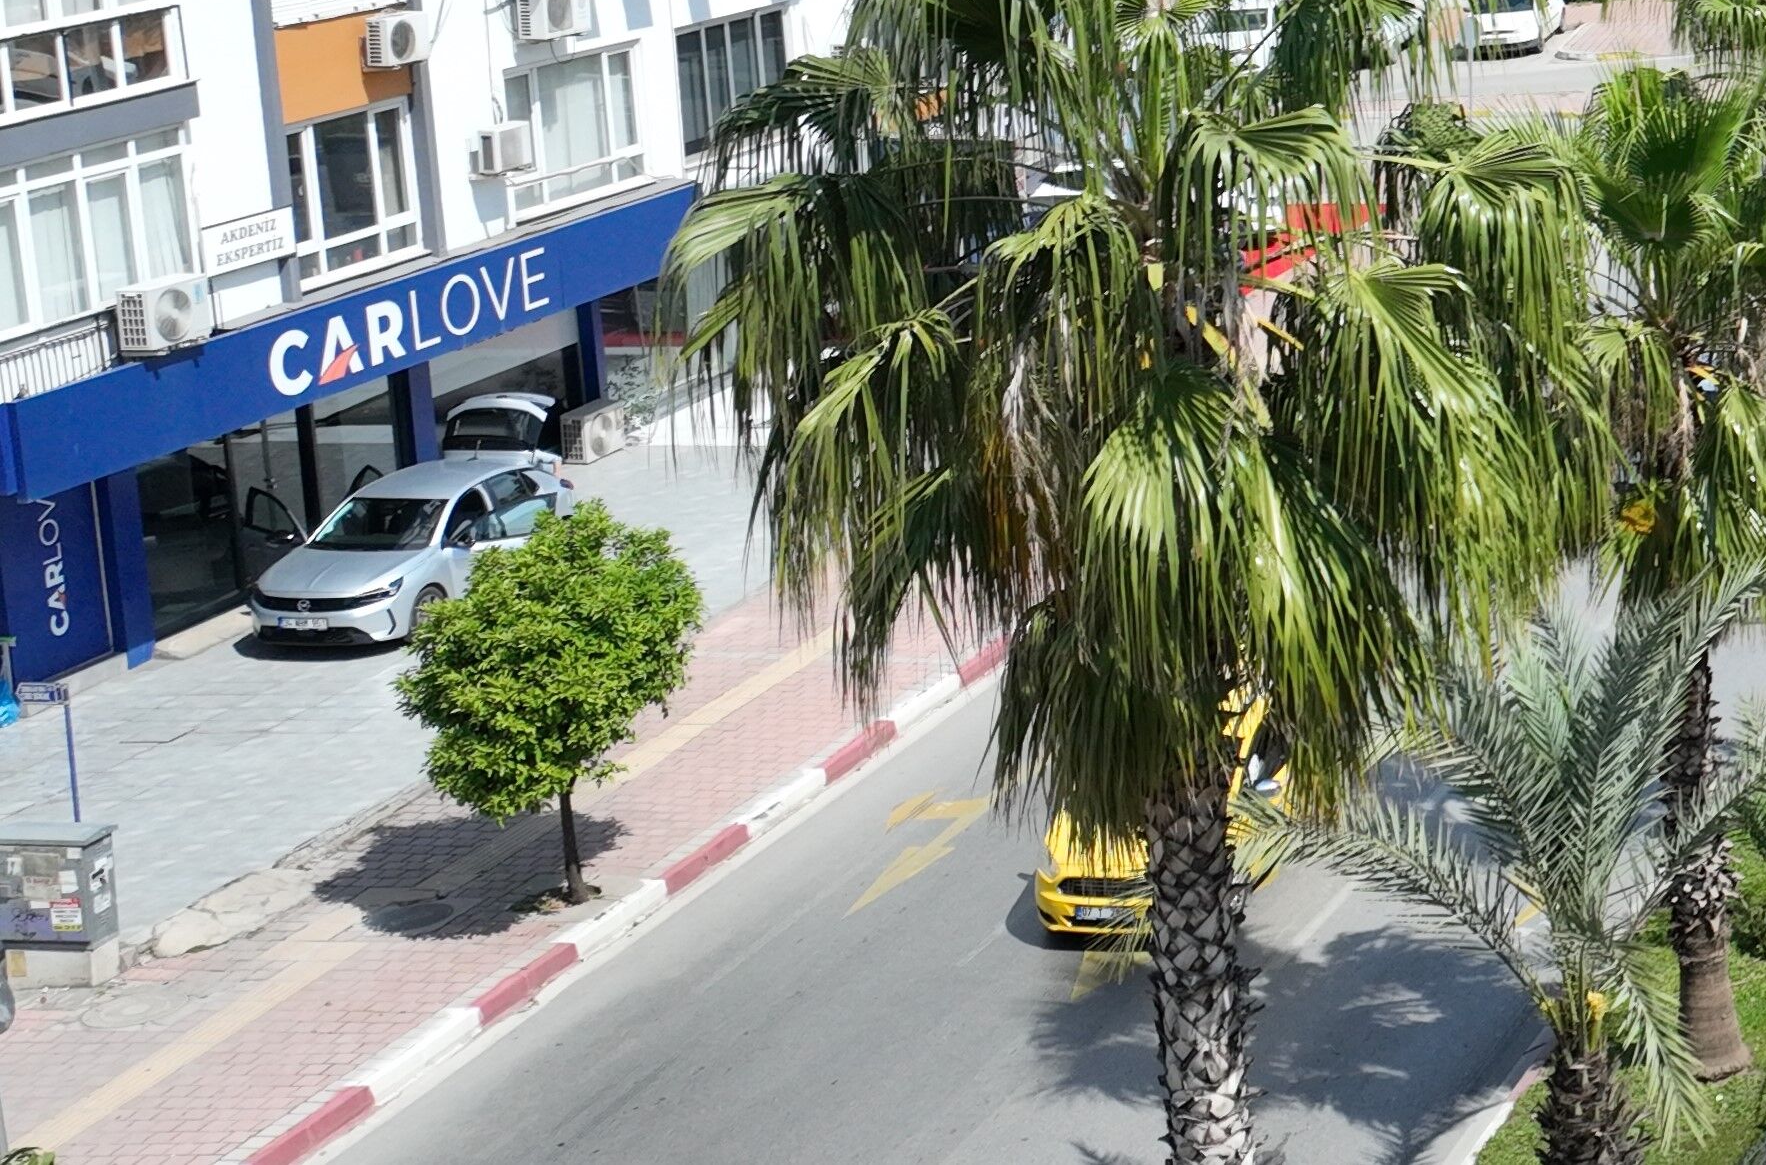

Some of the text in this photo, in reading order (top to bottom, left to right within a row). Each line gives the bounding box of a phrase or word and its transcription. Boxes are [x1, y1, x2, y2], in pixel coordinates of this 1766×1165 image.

[216, 234, 284, 266] EKSPERTİZ
[220, 217, 277, 245] AKDENİZ
[269, 247, 550, 396] CARLOVE
[38, 499, 70, 636] CARLOV
